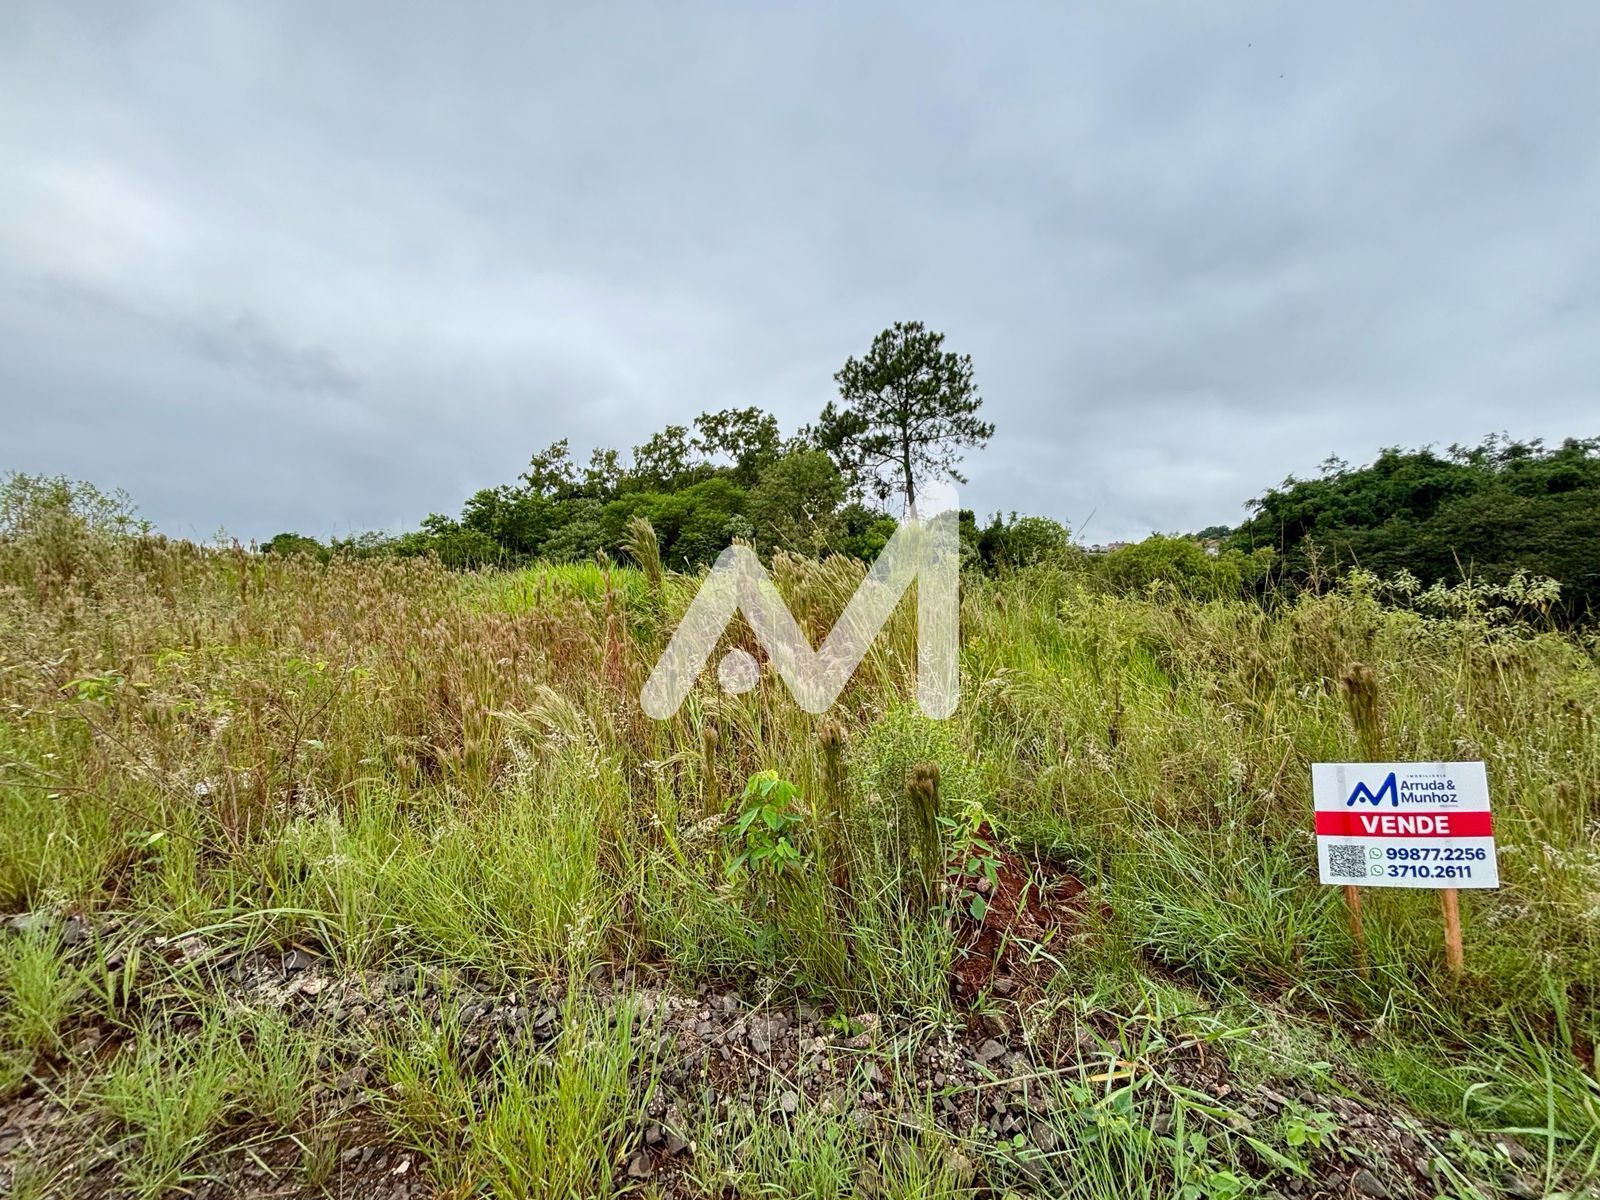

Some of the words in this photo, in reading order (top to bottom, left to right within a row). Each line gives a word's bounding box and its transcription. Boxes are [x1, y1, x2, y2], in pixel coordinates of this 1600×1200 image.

[1400, 780, 1445, 791] Arruda
[1446, 779, 1456, 791] &
[1401, 792, 1458, 803] Munhoz
[1360, 815, 1450, 834] VENDE
[1386, 847, 1486, 861] 99877.2256
[1388, 865, 1472, 878] 3710.2611
